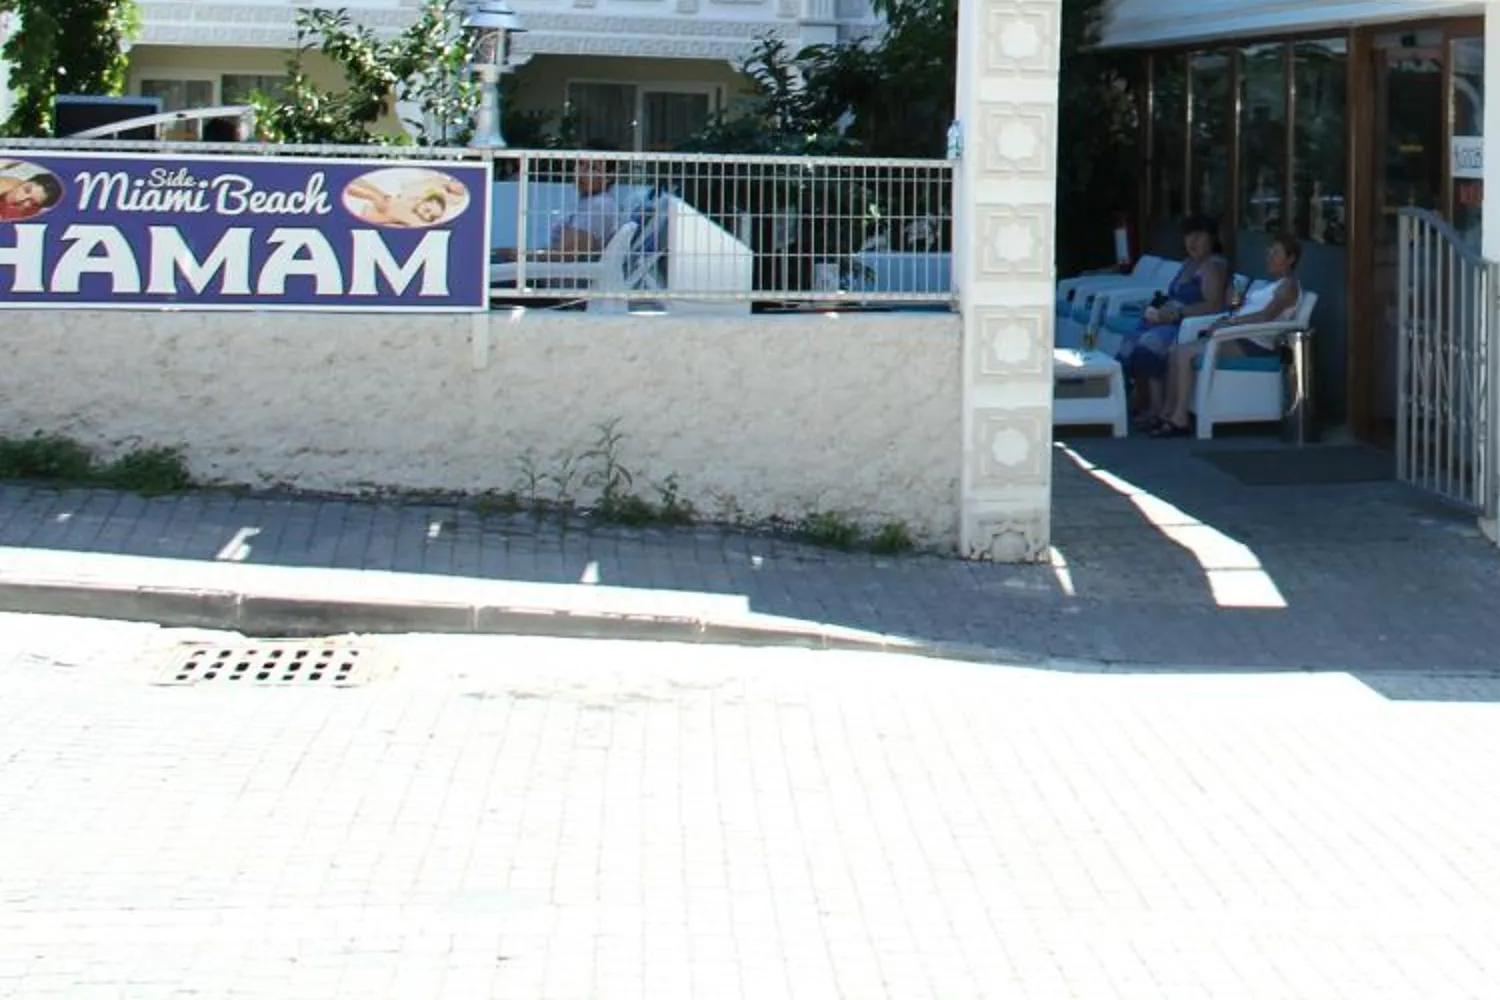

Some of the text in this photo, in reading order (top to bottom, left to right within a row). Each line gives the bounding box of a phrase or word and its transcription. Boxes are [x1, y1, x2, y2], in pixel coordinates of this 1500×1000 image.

[74, 170, 332, 216] Miami Beach
[149, 167, 197, 188] Side
